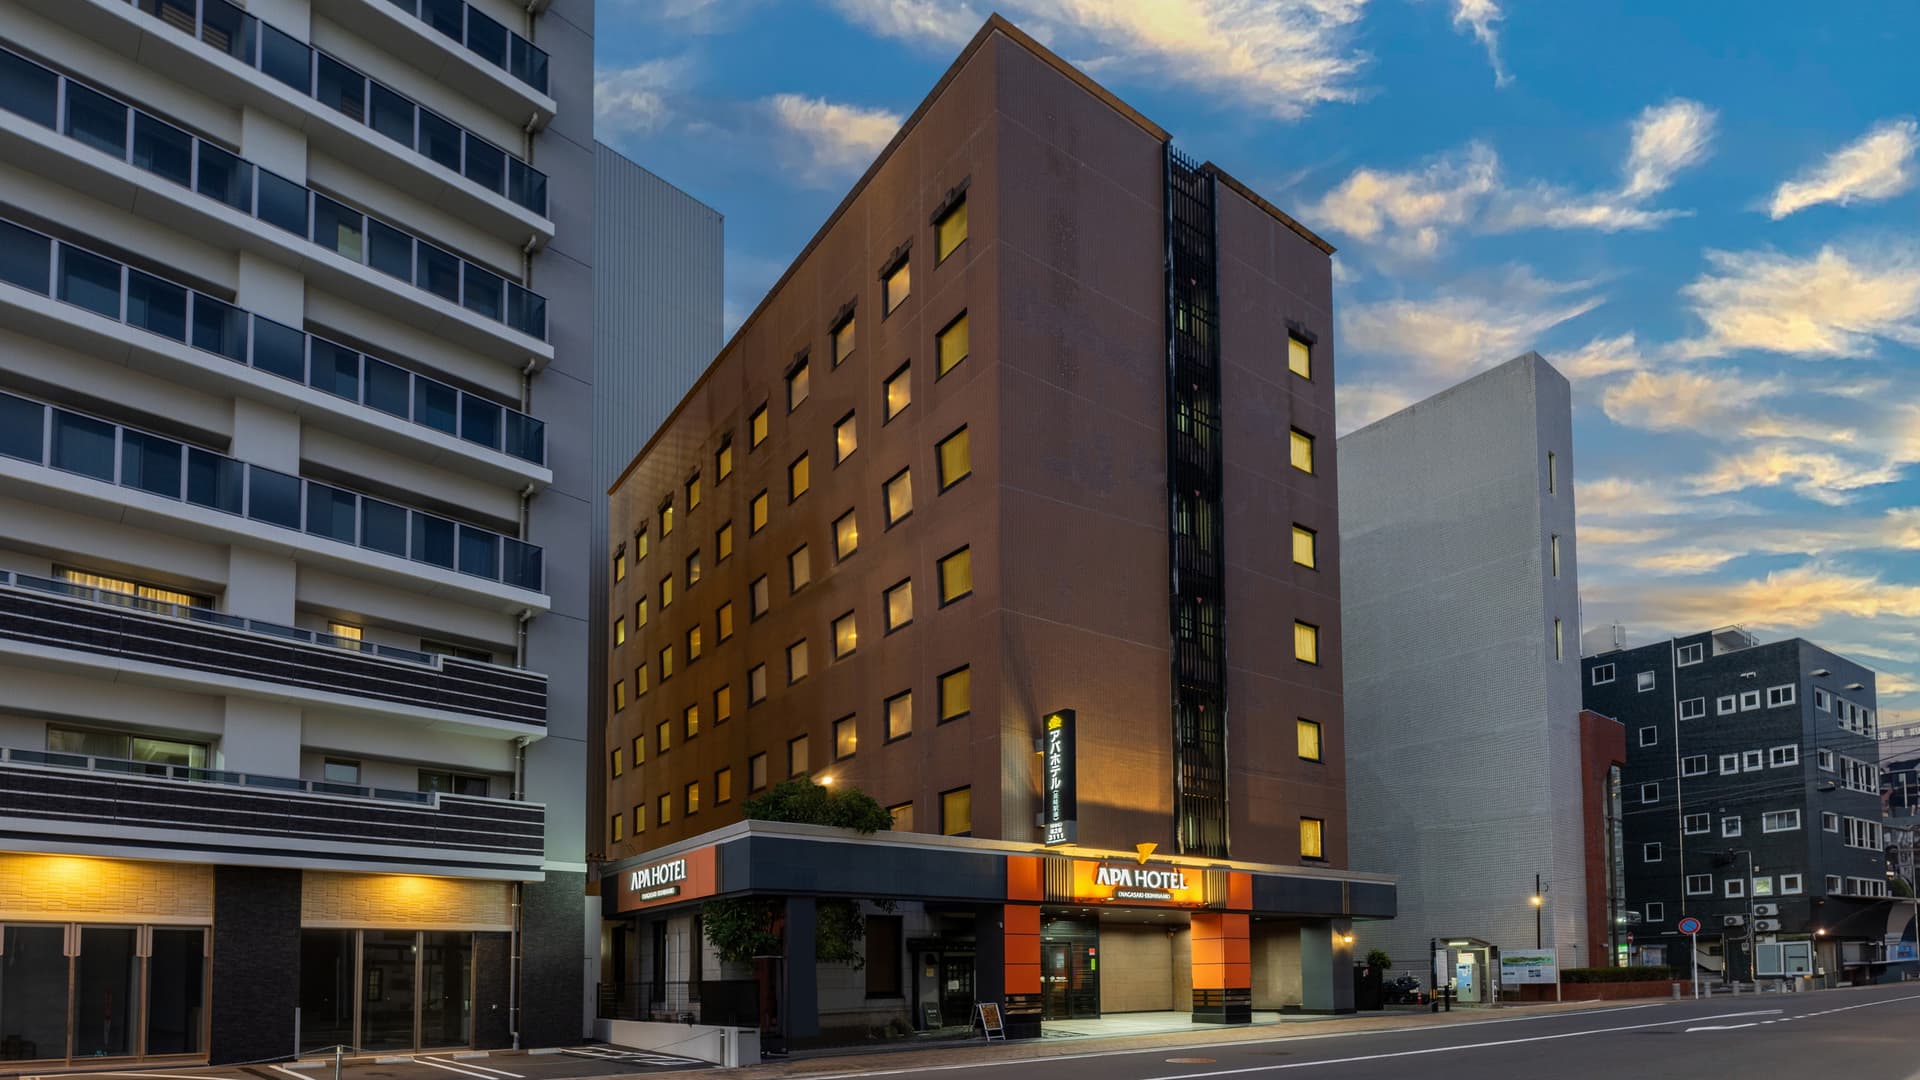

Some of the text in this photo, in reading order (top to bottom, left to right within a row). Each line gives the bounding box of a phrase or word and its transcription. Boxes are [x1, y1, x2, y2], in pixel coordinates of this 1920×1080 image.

[1050, 729, 1061, 790] アパホテル
[631, 859, 686, 891] APA HOTEL
[1096, 867, 1189, 889] APA HOTEL
